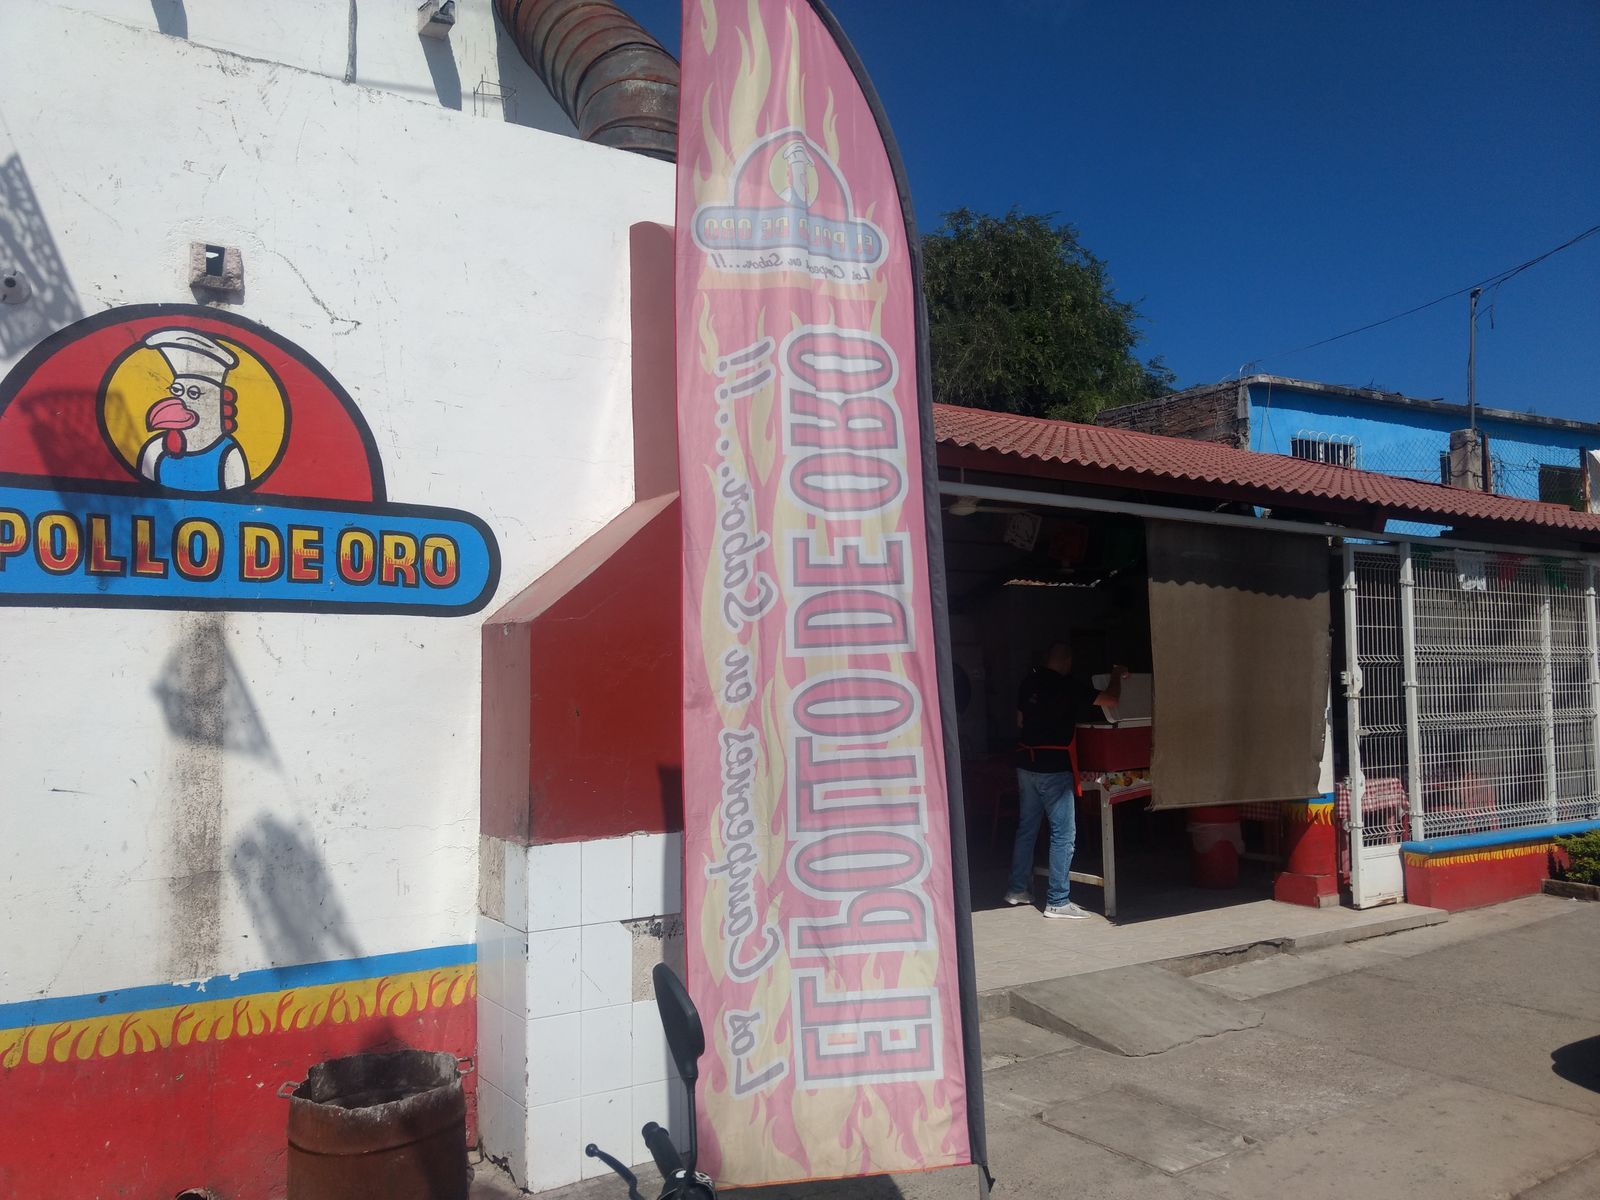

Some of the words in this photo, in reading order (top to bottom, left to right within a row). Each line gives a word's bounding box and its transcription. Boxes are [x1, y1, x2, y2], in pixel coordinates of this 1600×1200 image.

[0, 507, 225, 582] POLLO
[239, 521, 324, 583] DE
[336, 527, 461, 590] ORO
